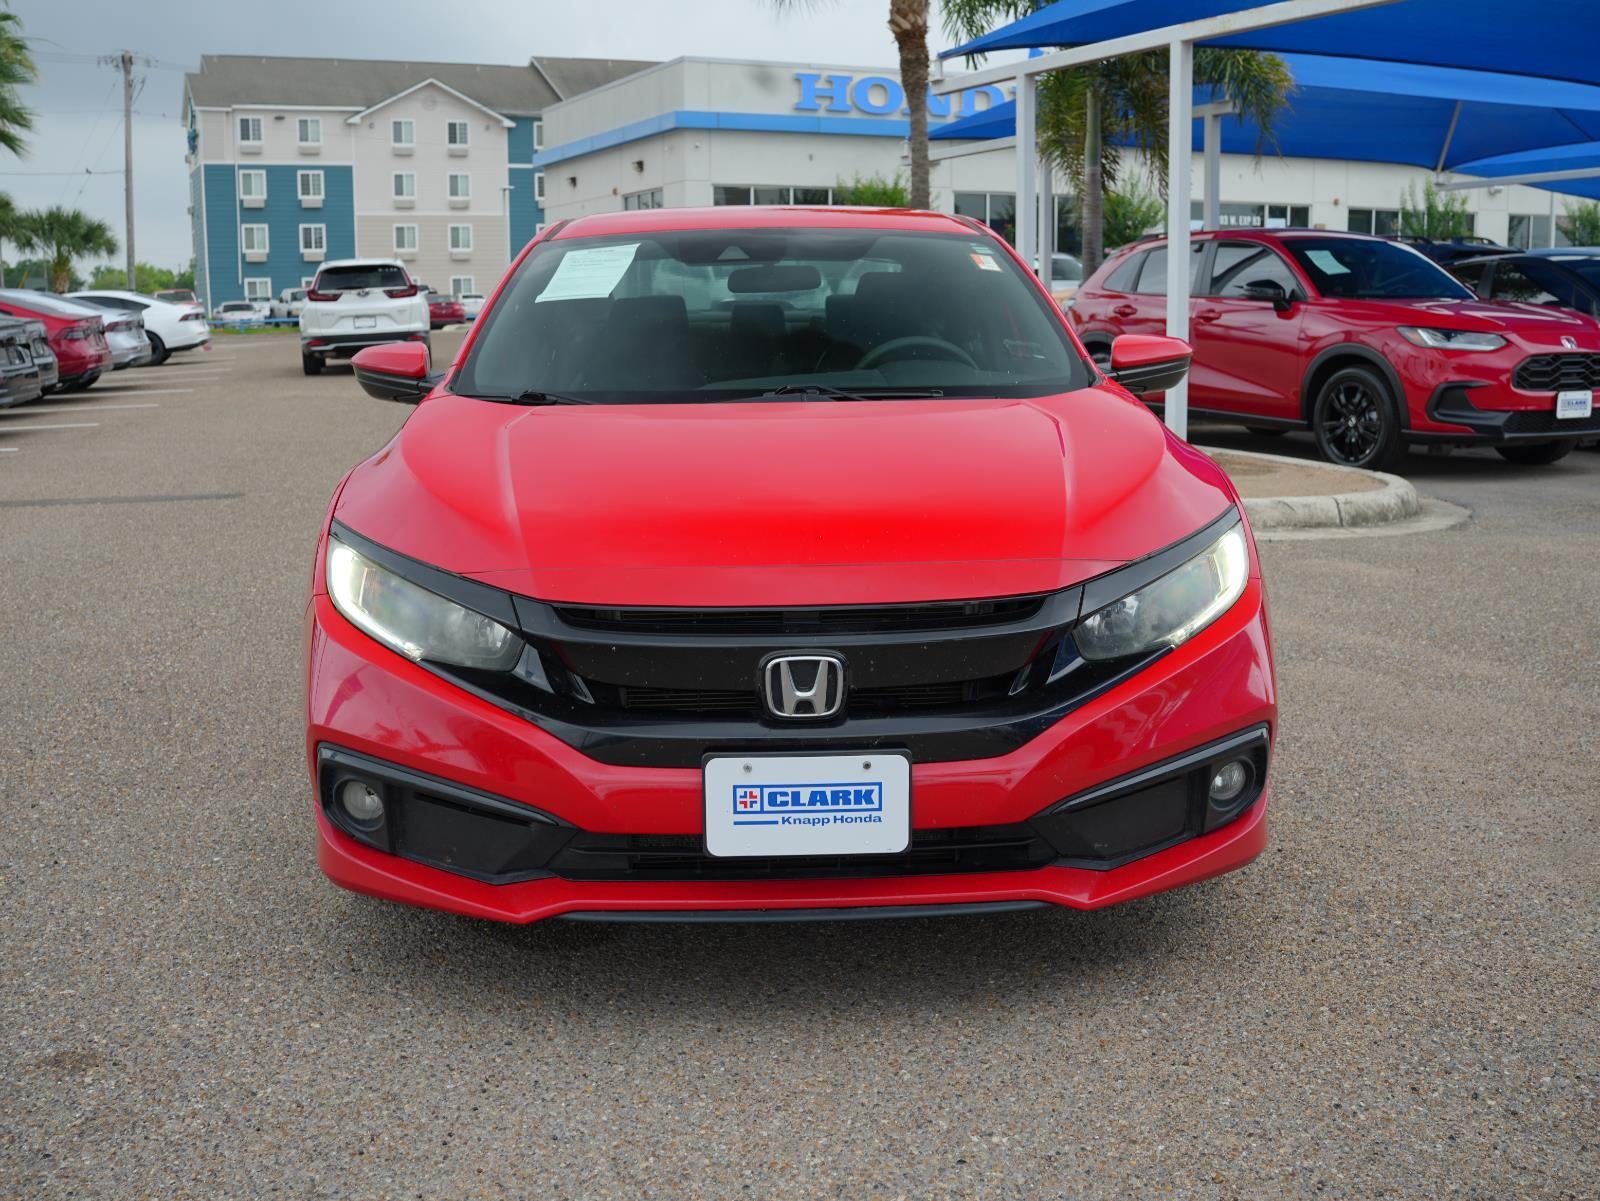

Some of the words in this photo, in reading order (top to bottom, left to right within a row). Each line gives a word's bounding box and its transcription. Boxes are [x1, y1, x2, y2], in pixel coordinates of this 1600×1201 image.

[794, 72, 1016, 118] HOND
[767, 788, 875, 807] CLARK
[781, 815, 830, 826] Knapp
[834, 814, 882, 825] Honda
